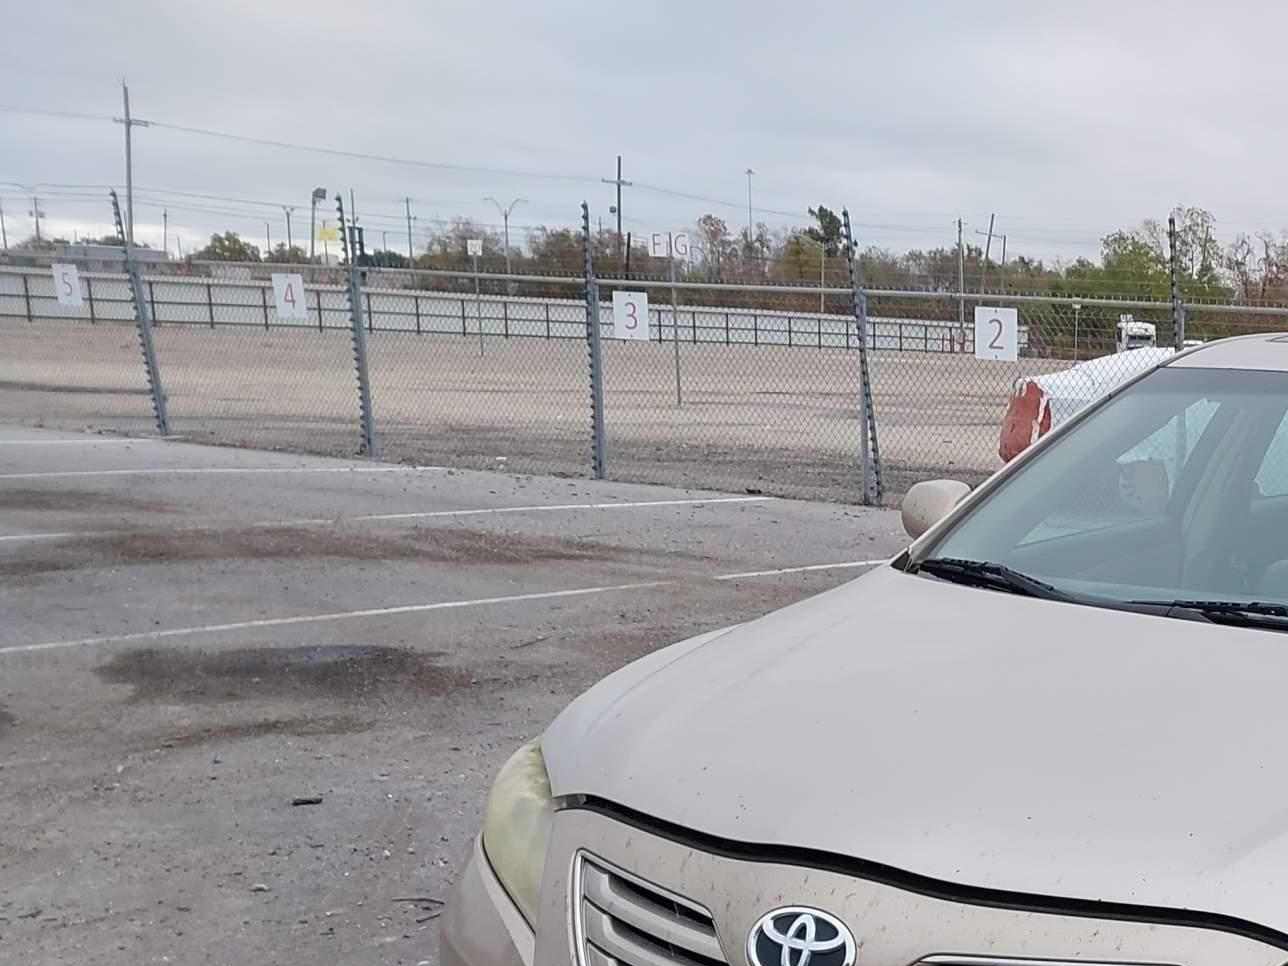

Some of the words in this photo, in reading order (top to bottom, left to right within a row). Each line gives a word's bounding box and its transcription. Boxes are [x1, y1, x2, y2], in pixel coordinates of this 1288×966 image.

[652, 234, 661, 255] F
[674, 234, 687, 255] G
[62, 272, 73, 297] 5
[284, 283, 296, 309] 4
[625, 302, 638, 329] 3
[989, 319, 1004, 350] 2
